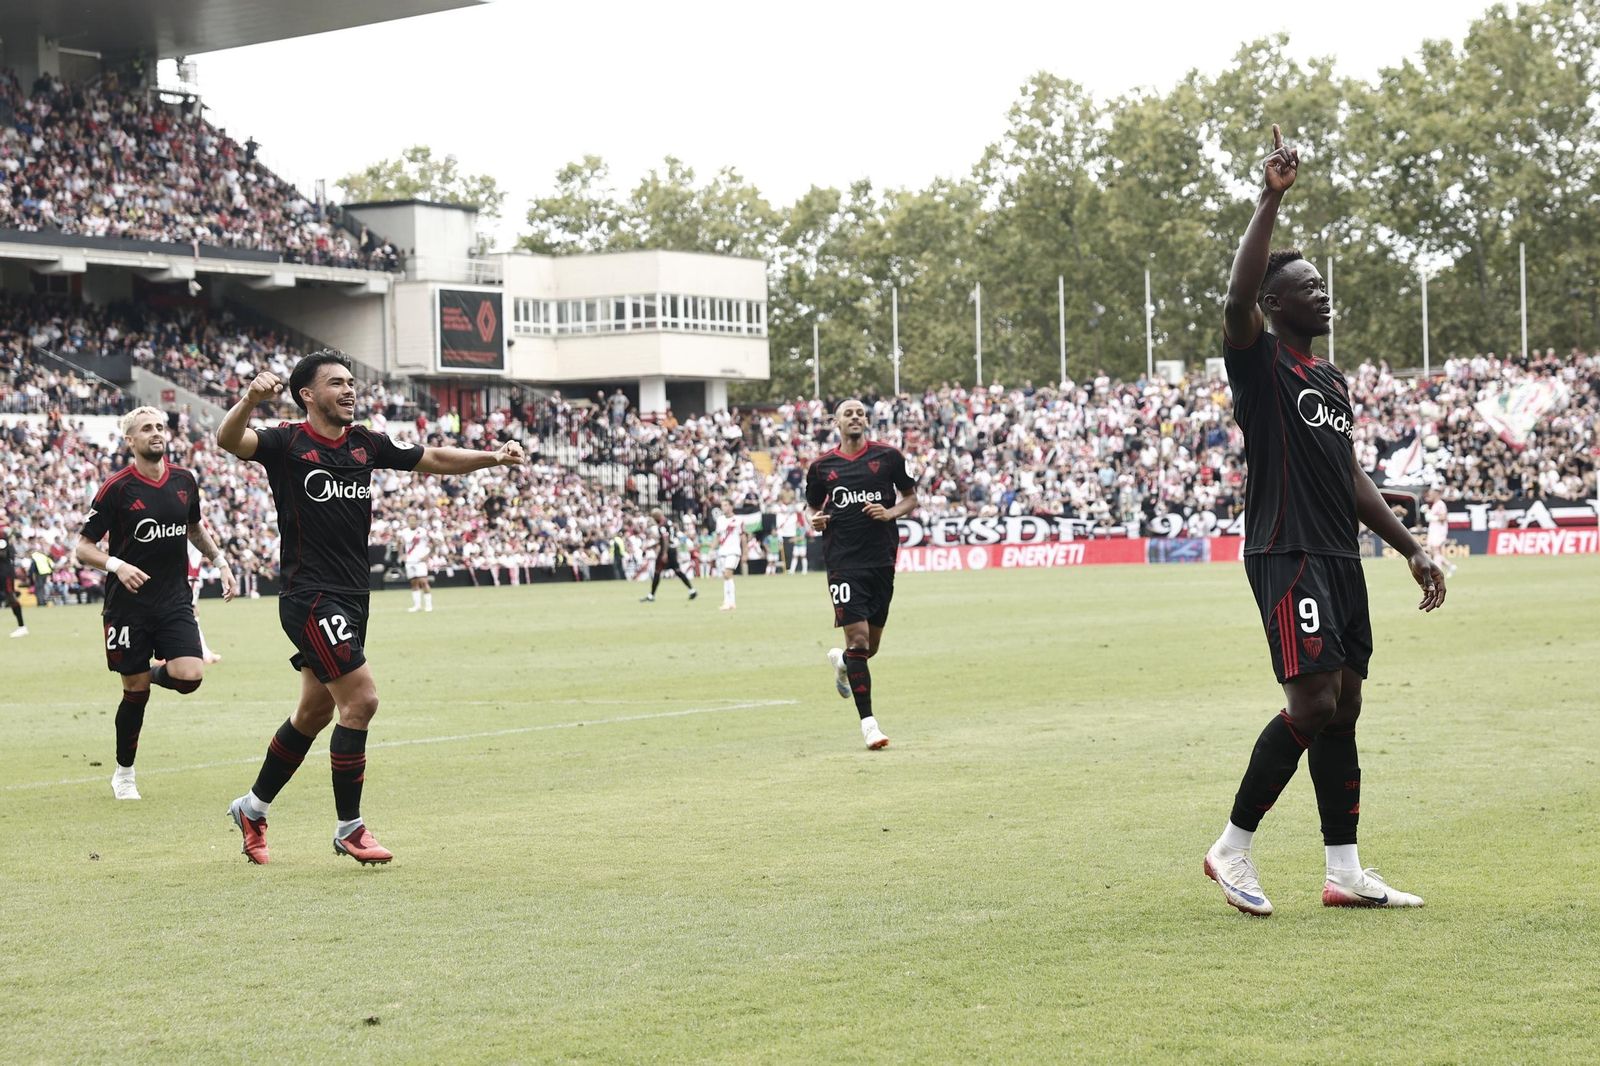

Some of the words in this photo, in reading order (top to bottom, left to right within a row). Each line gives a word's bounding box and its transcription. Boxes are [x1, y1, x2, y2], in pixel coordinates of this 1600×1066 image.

[304, 469, 371, 503] Midea
[832, 486, 882, 508] Midea
[133, 517, 187, 543] Midea
[1495, 528, 1598, 556] ENERYETI
[895, 547, 963, 572] ALIGA
[1001, 542, 1085, 568] ENERYETI
[830, 582, 850, 605] 20
[1298, 597, 1320, 634] 9
[107, 626, 130, 650] 24
[318, 614, 353, 646] 12
